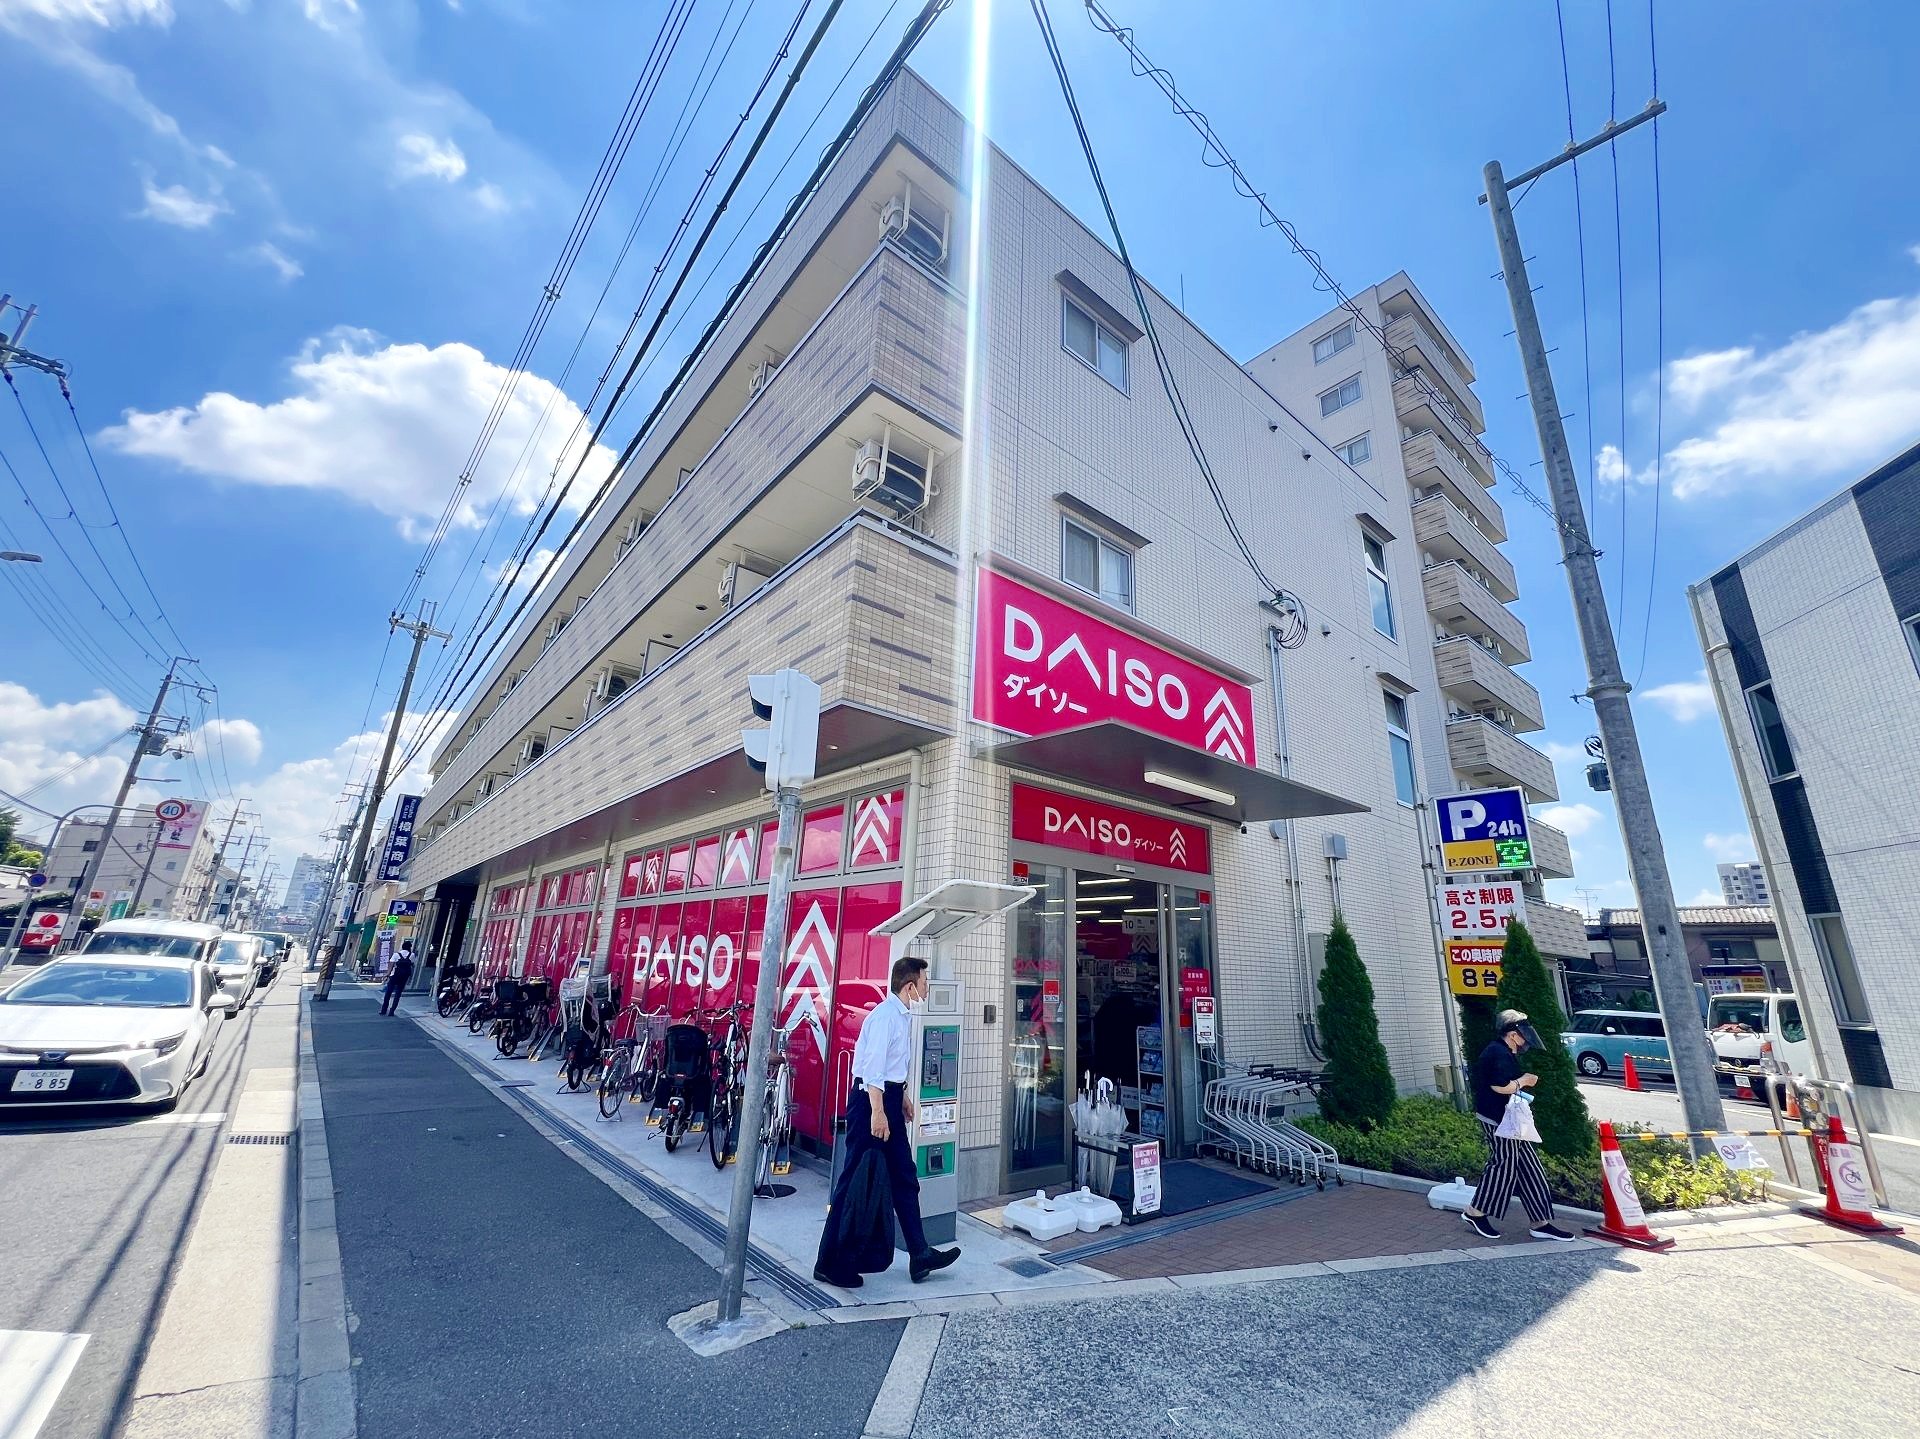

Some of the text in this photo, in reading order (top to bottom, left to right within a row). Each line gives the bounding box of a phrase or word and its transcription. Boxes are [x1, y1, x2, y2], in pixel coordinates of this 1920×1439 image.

[1004, 604, 1189, 720] DAISO
[1003, 673, 1088, 714] ダイソー
[162, 805, 180, 816] 40
[1448, 800, 1522, 840] P 24h
[1044, 806, 1164, 852] DAISO ダイソー
[1448, 855, 1494, 867] P.ZONE
[392, 902, 407, 915] P
[1445, 888, 1515, 906] 高さ制限
[633, 934, 734, 990] DAISO
[1462, 968, 1498, 988] 8台
